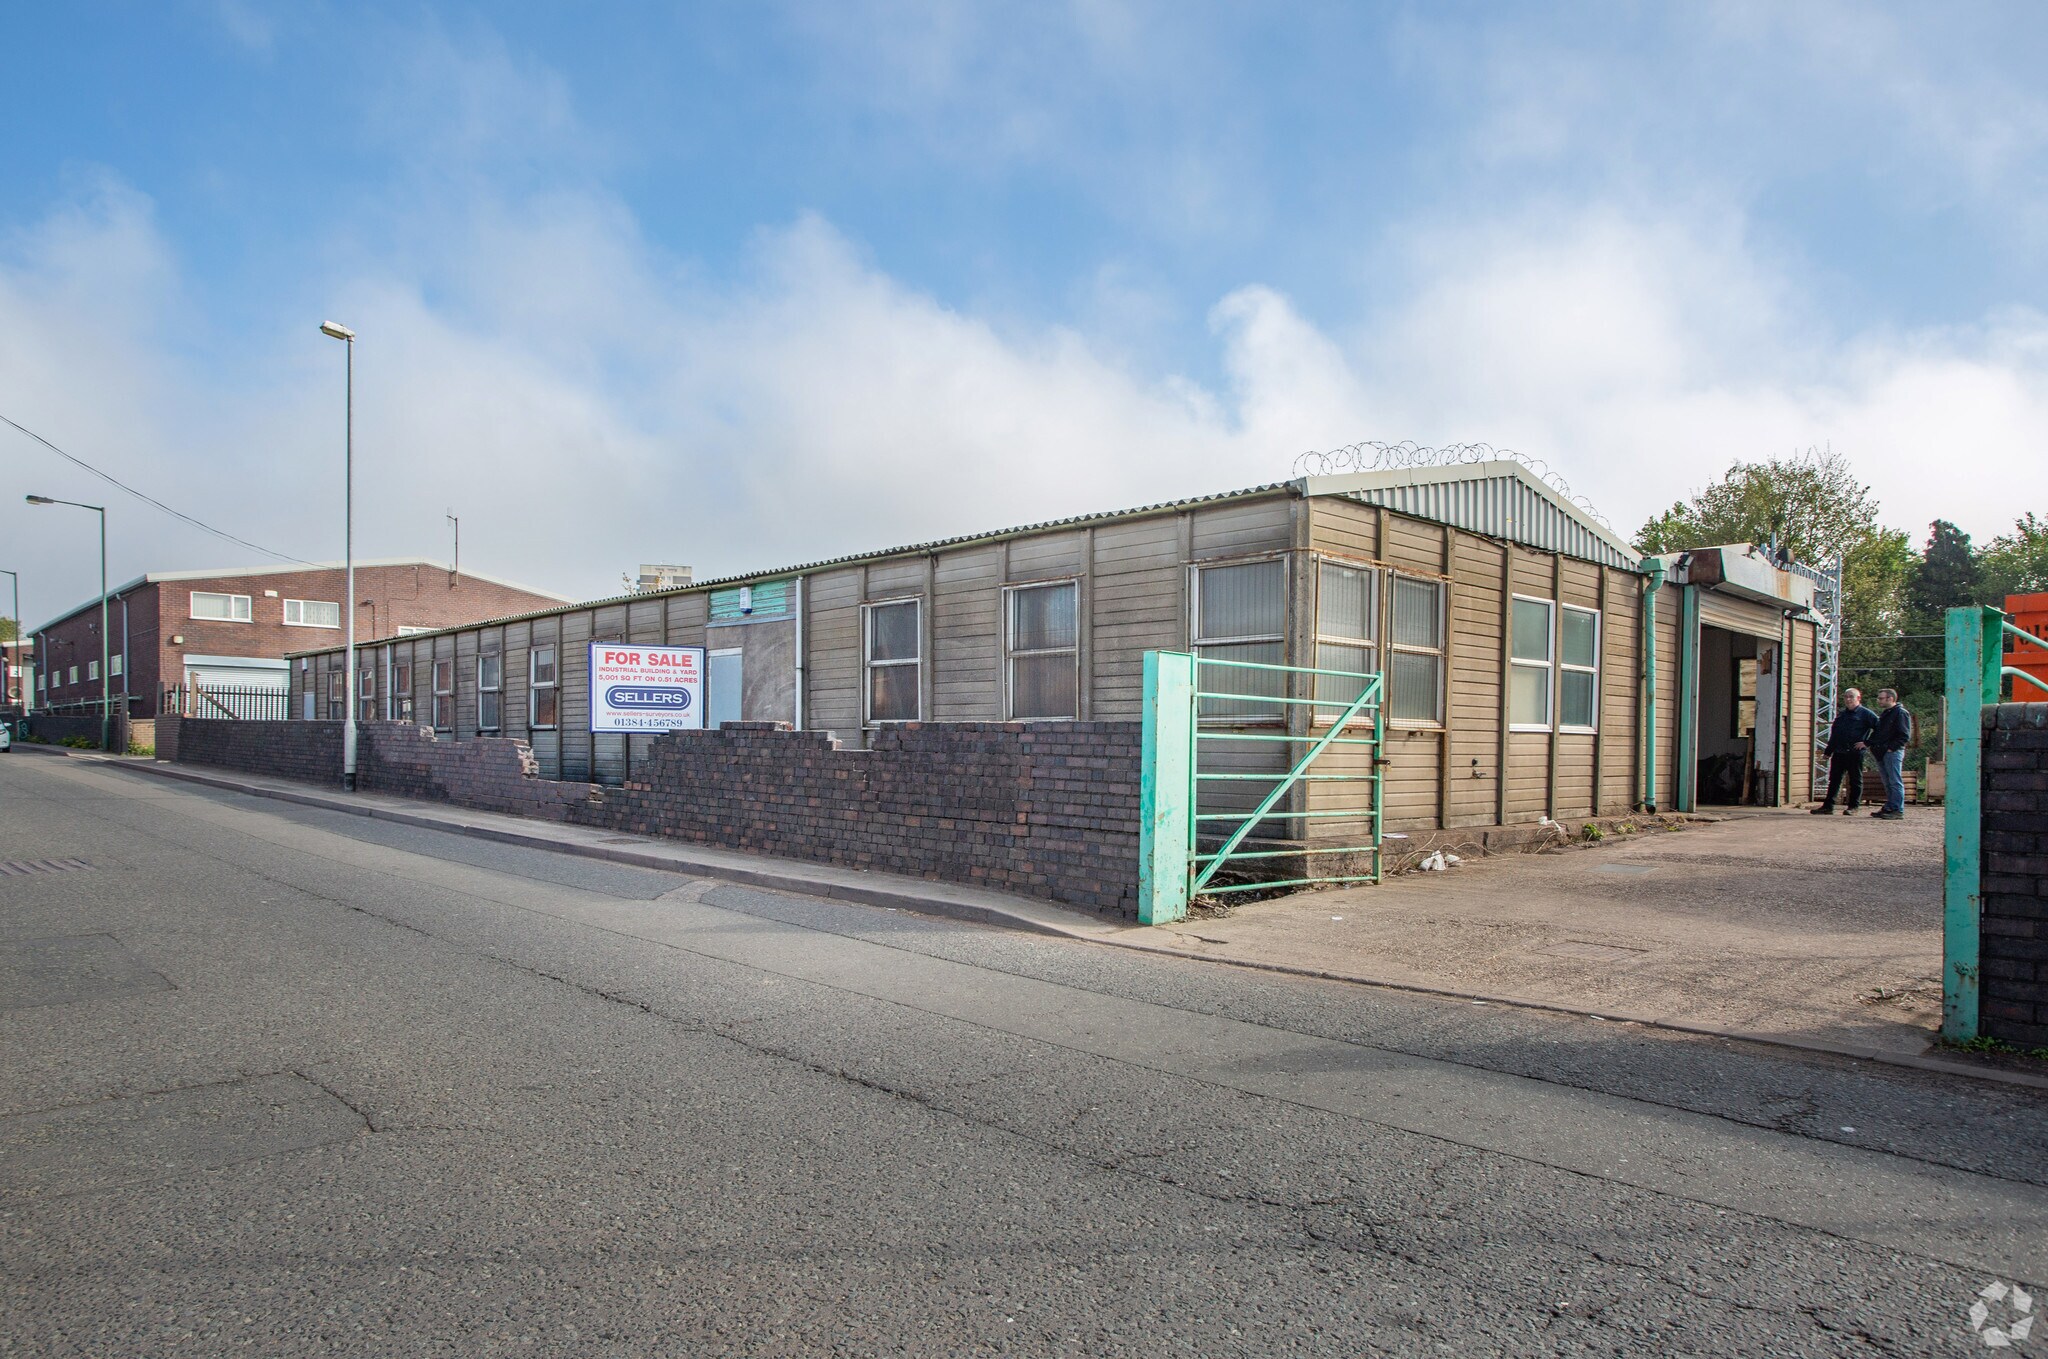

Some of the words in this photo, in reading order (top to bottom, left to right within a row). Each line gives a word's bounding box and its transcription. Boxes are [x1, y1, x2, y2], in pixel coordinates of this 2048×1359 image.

[604, 652, 640, 665] FOR
[648, 653, 692, 667] SALE
[614, 692, 683, 703] SELLERS
